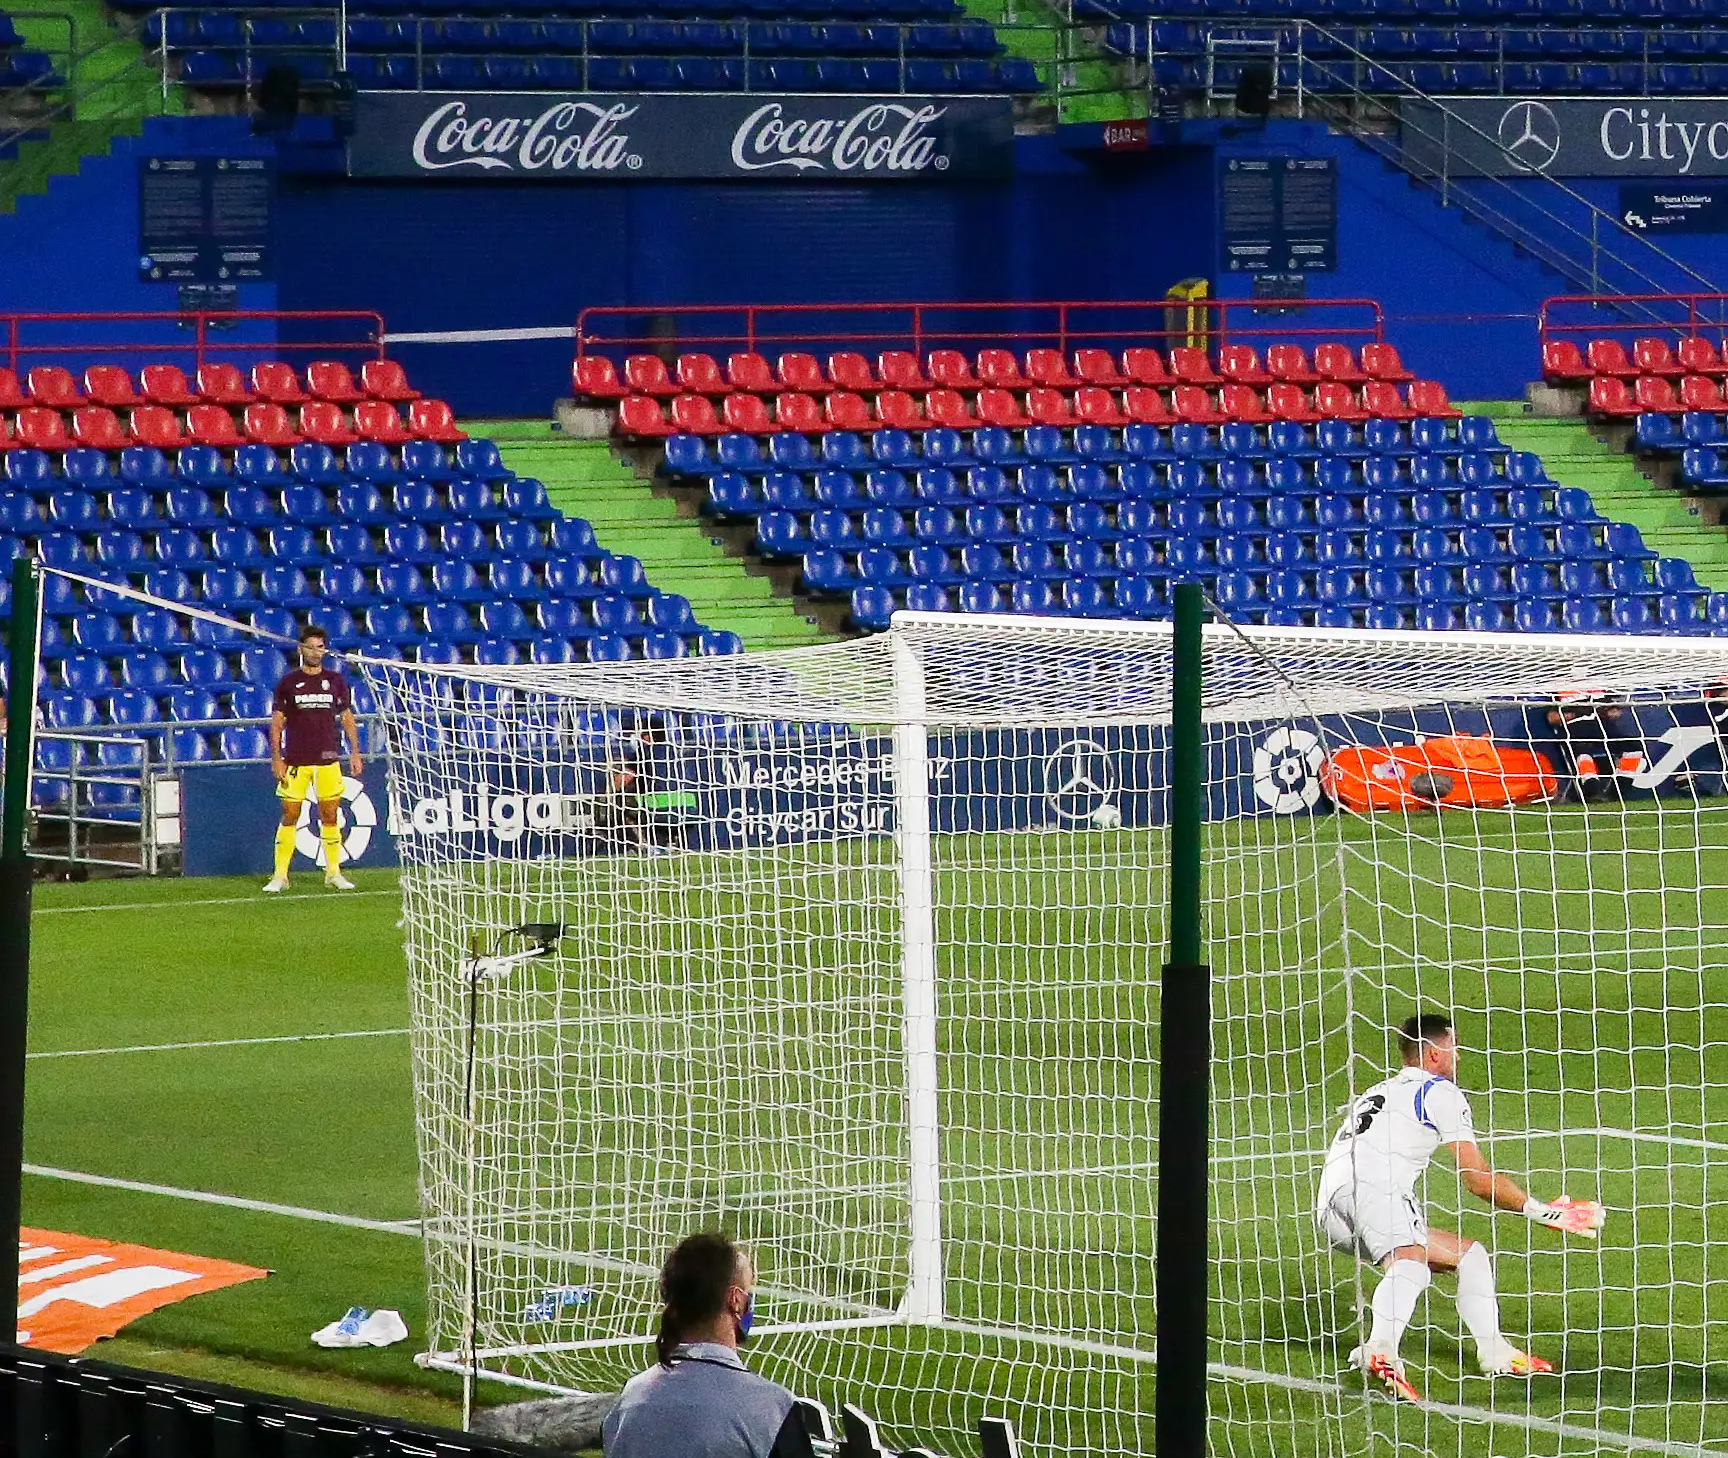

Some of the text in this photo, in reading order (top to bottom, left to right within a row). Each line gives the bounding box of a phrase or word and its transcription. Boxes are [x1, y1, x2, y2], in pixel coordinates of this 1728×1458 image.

[412, 101, 629, 171] Coca-Cola
[731, 103, 937, 172] Coca-Cola
[388, 786, 563, 842] LaLiga
